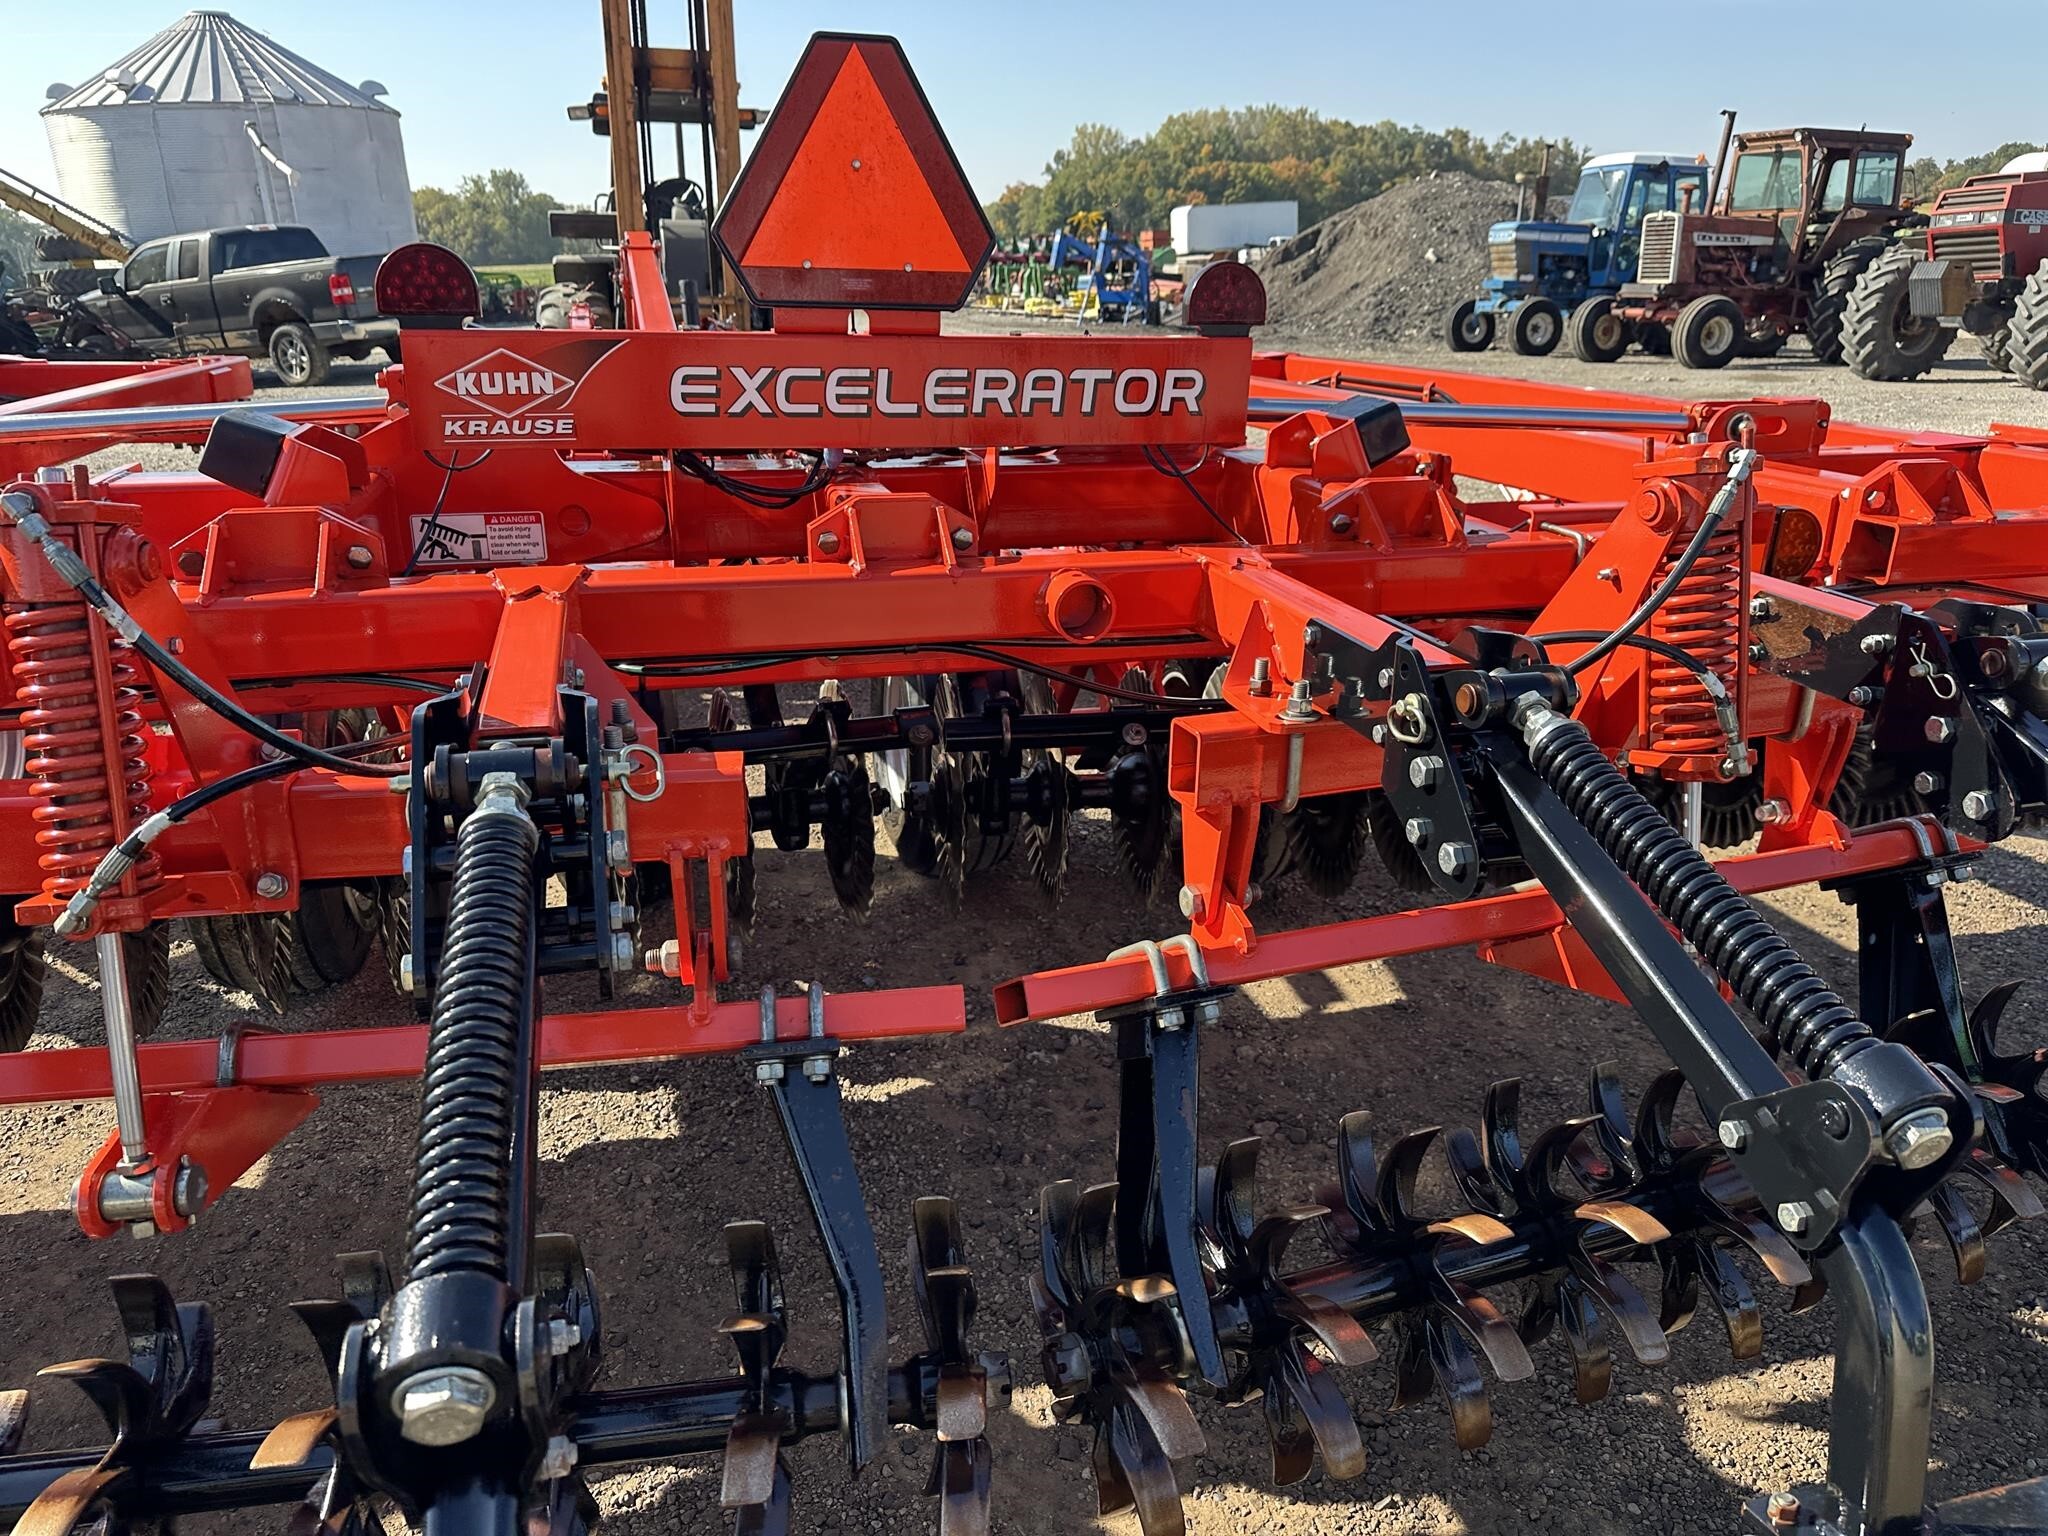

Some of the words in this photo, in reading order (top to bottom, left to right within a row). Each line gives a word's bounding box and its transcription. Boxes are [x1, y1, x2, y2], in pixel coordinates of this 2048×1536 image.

[455, 371, 554, 395] KUHN
[670, 366, 1204, 416] EXCELERATOR
[444, 419, 574, 436] KRAUSE
